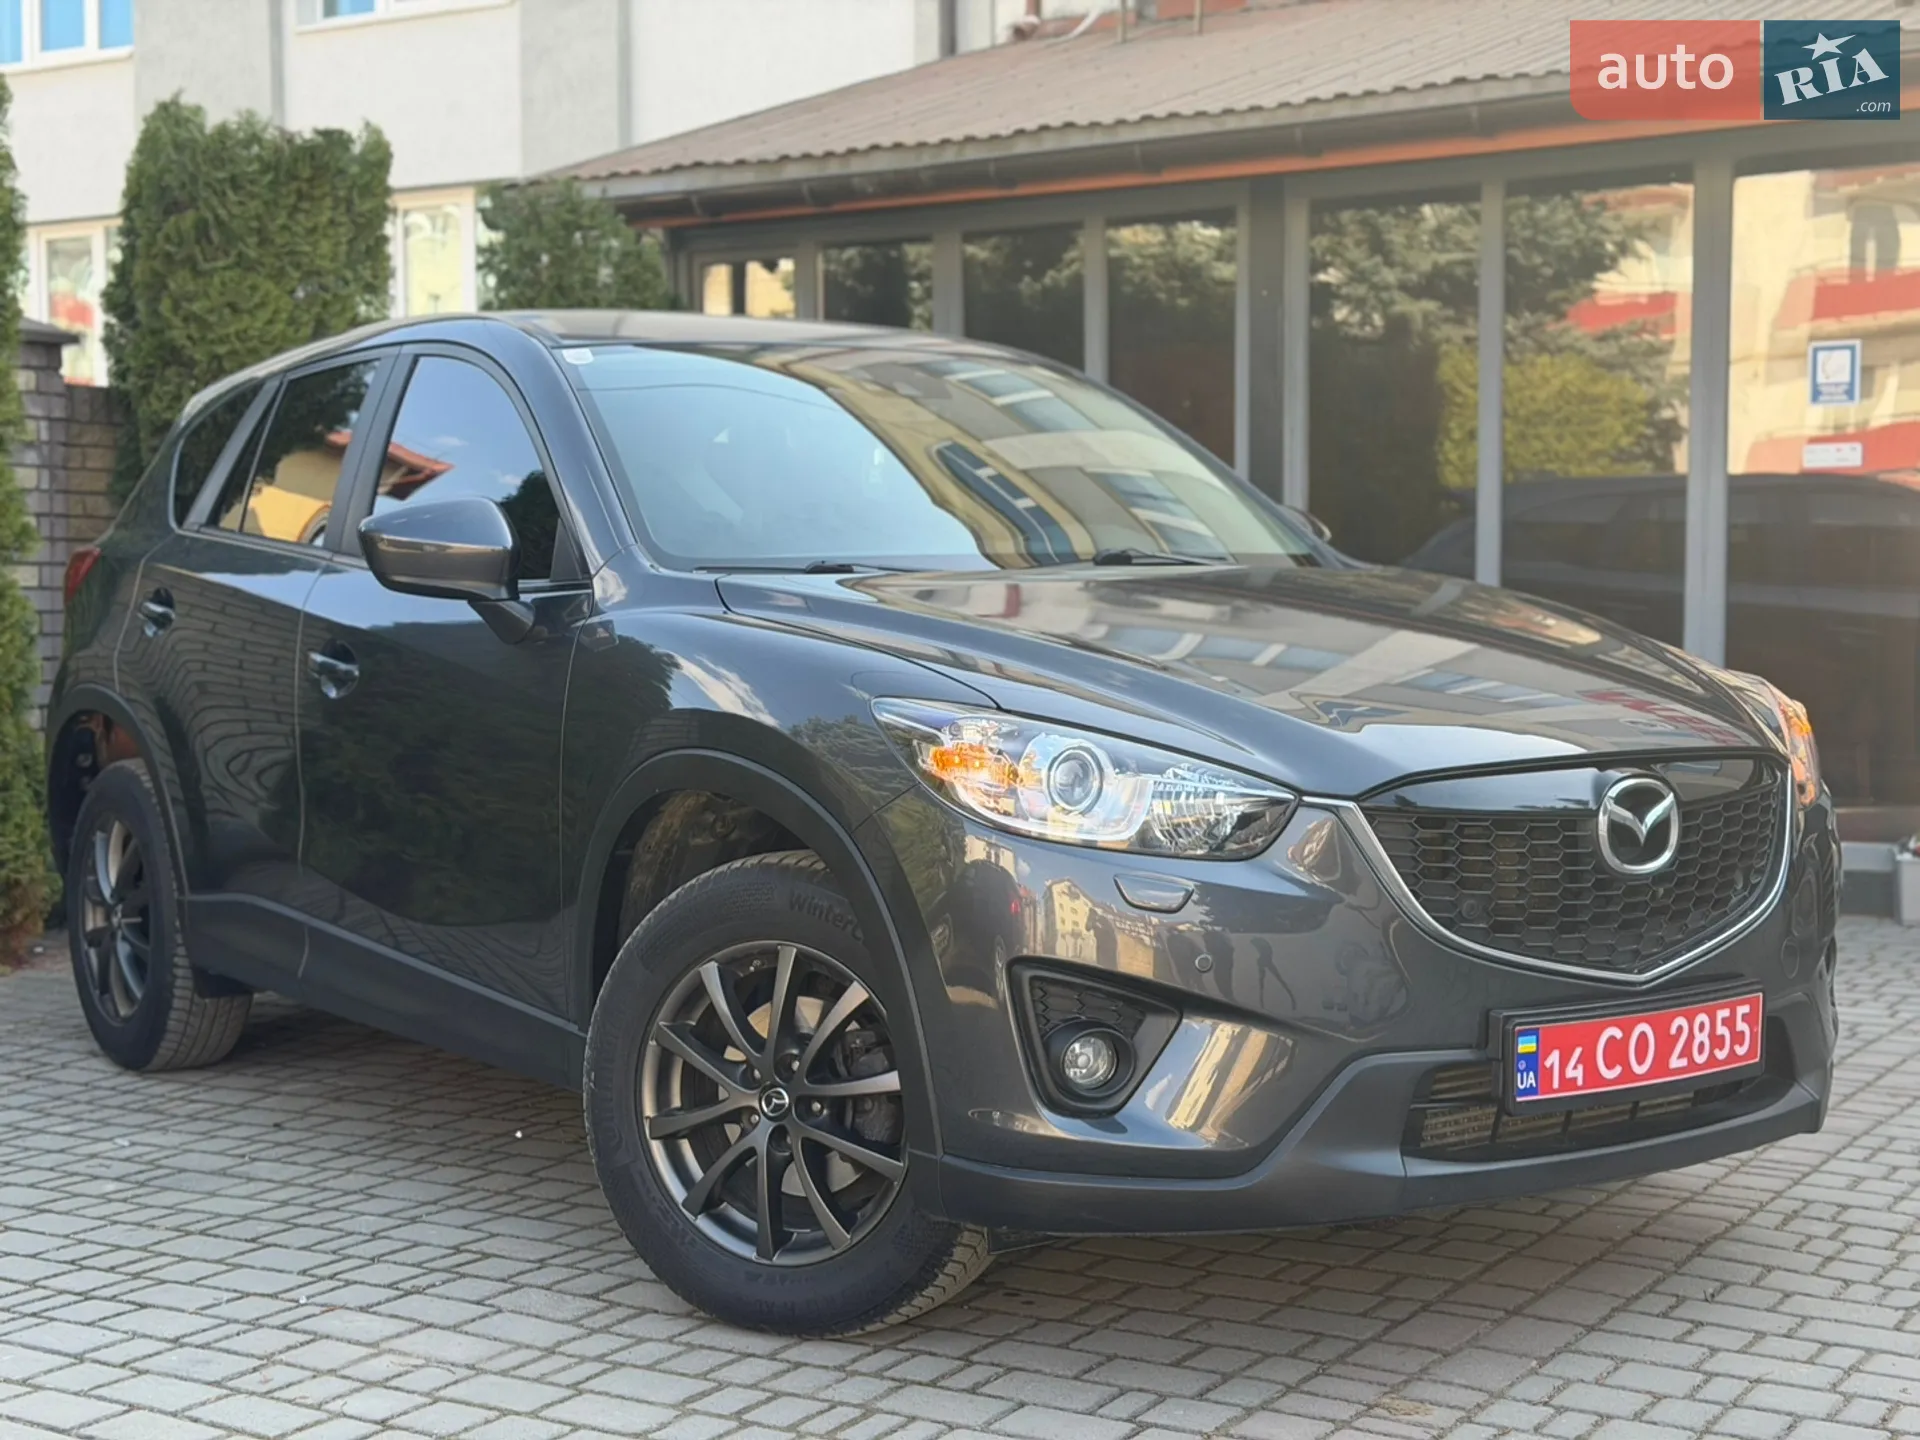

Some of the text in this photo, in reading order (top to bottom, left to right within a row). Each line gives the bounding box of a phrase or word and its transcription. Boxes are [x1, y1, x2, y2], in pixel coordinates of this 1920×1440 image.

[1543, 1004, 1751, 1089] 14 CO 2855
[1517, 1072, 1536, 1089] UA
